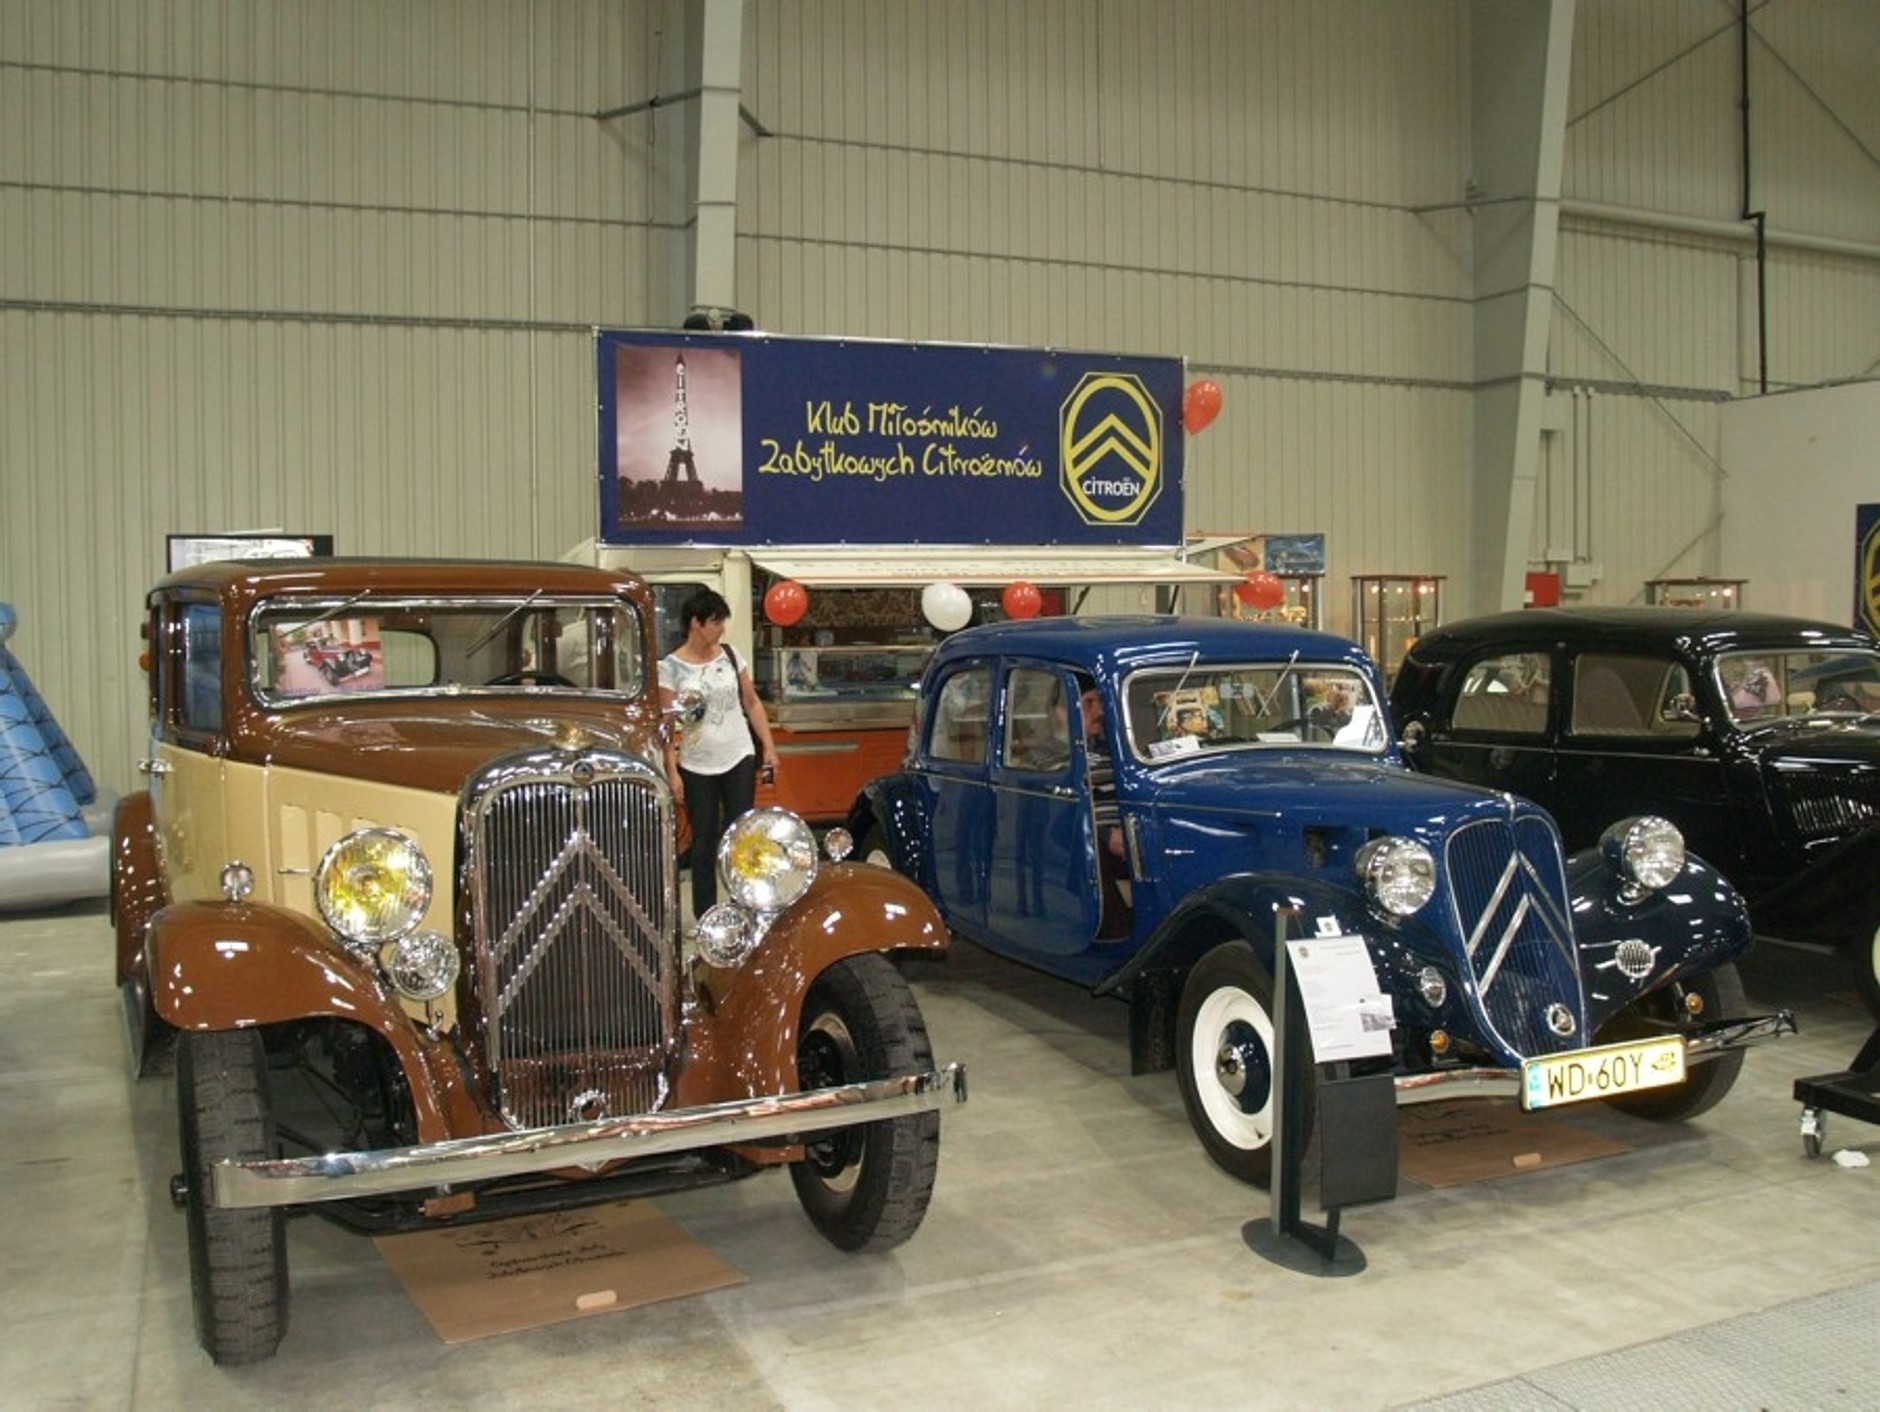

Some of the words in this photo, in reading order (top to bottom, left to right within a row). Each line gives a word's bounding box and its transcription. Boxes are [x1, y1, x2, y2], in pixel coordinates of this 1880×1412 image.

[806, 400, 860, 435] Klub
[758, 438, 914, 482] Zabytkowych
[1548, 1063, 1585, 1100] WD
[1596, 1052, 1643, 1090] 60Y
